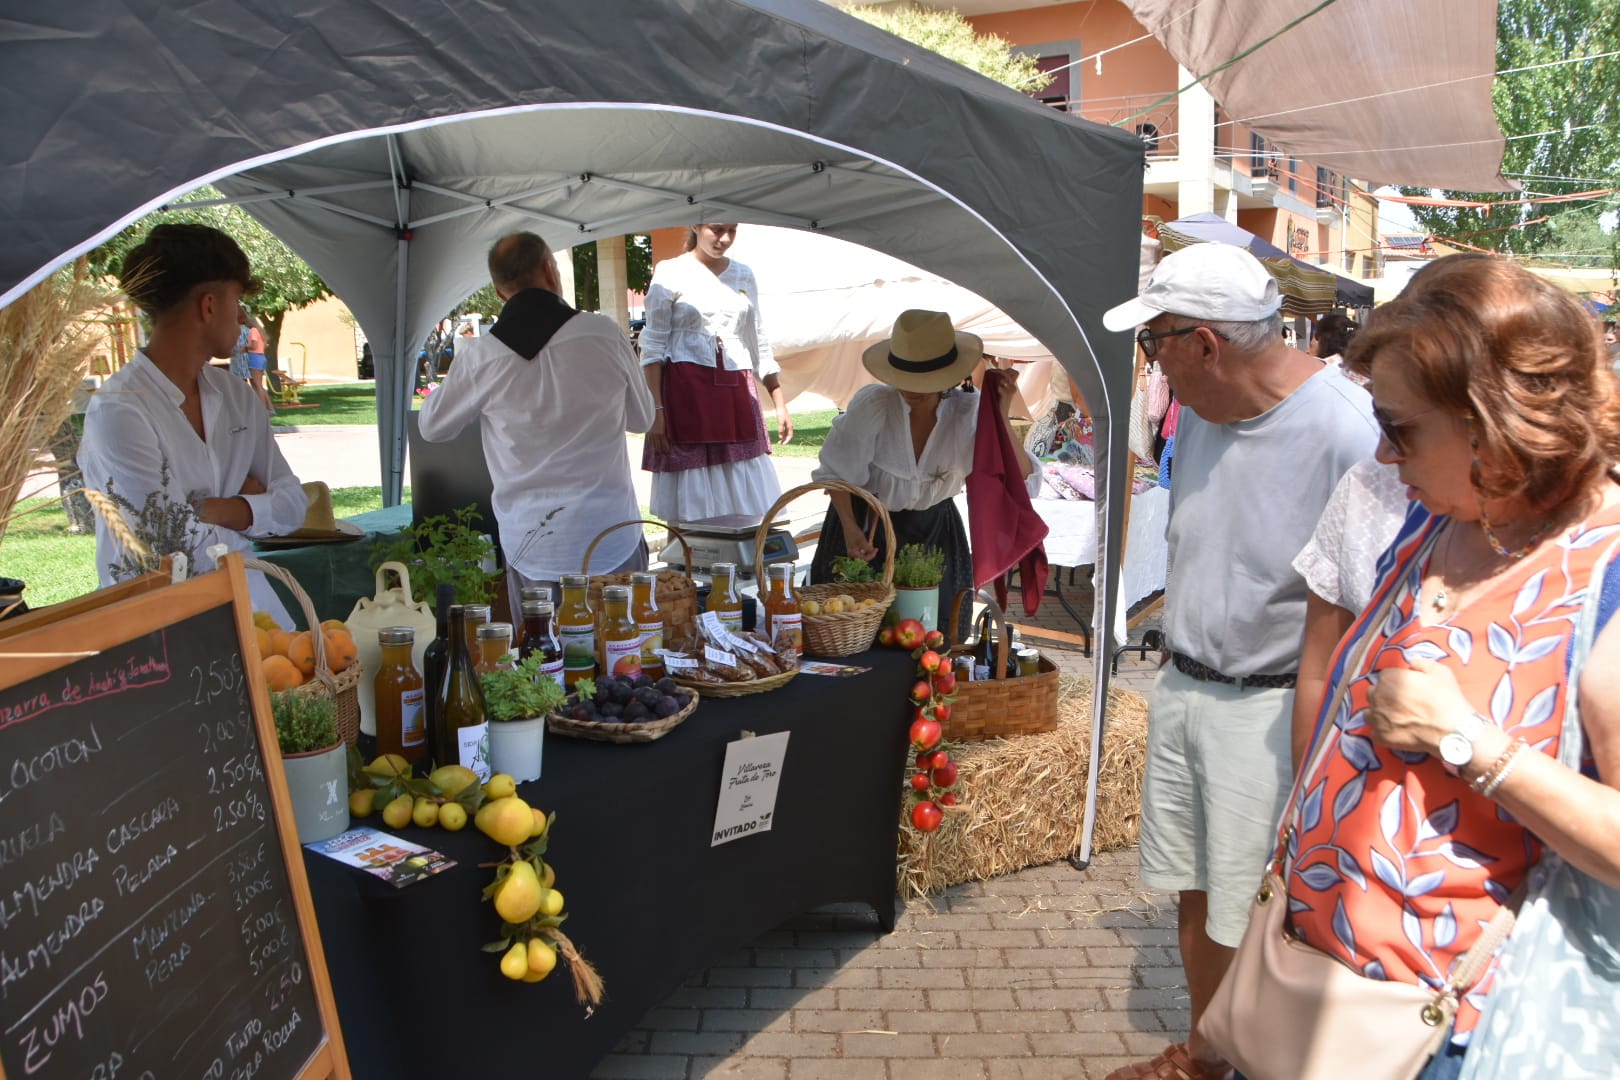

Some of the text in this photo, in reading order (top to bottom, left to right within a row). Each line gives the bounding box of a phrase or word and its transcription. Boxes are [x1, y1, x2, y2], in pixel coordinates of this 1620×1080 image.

[62, 672, 82, 701] de
[714, 820, 757, 841] INVITADO
[1, 898, 104, 999] ALMENDRA
[144, 942, 192, 992] PERA
[19, 971, 108, 1075] ZUMOS
